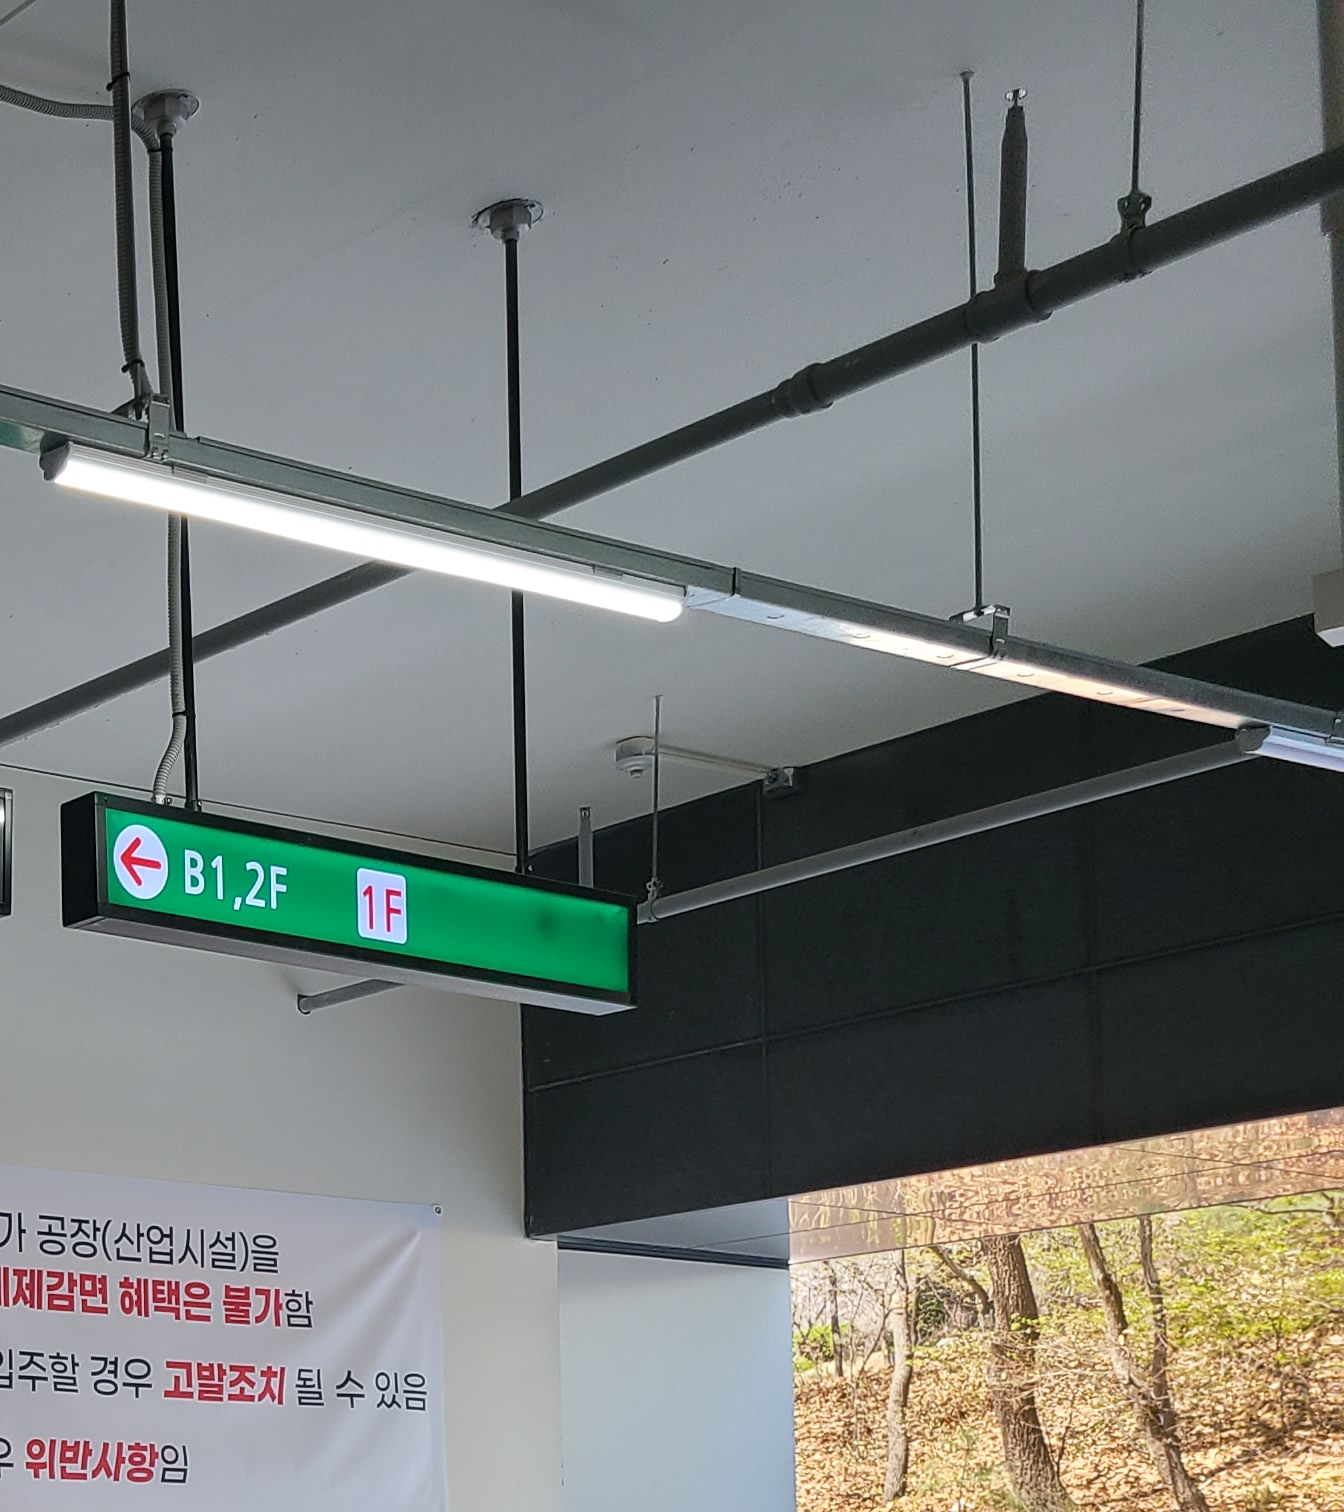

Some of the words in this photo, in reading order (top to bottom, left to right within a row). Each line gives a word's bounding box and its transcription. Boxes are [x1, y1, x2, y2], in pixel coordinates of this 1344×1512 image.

[184, 848, 288, 911] B1,2F
[362, 885, 402, 934] 1F
[36, 1215, 280, 1274] 공장(산업시설)을
[118, 1278, 213, 1324] 혜택은
[221, 1285, 314, 1329] 불가함
[90, 1357, 153, 1398] 경우
[163, 1360, 285, 1406] 고발조치
[294, 1368, 324, 1407] 될
[335, 1371, 366, 1409] 수
[374, 1372, 427, 1411] 있음
[25, 1438, 189, 1485] 위반사항임
